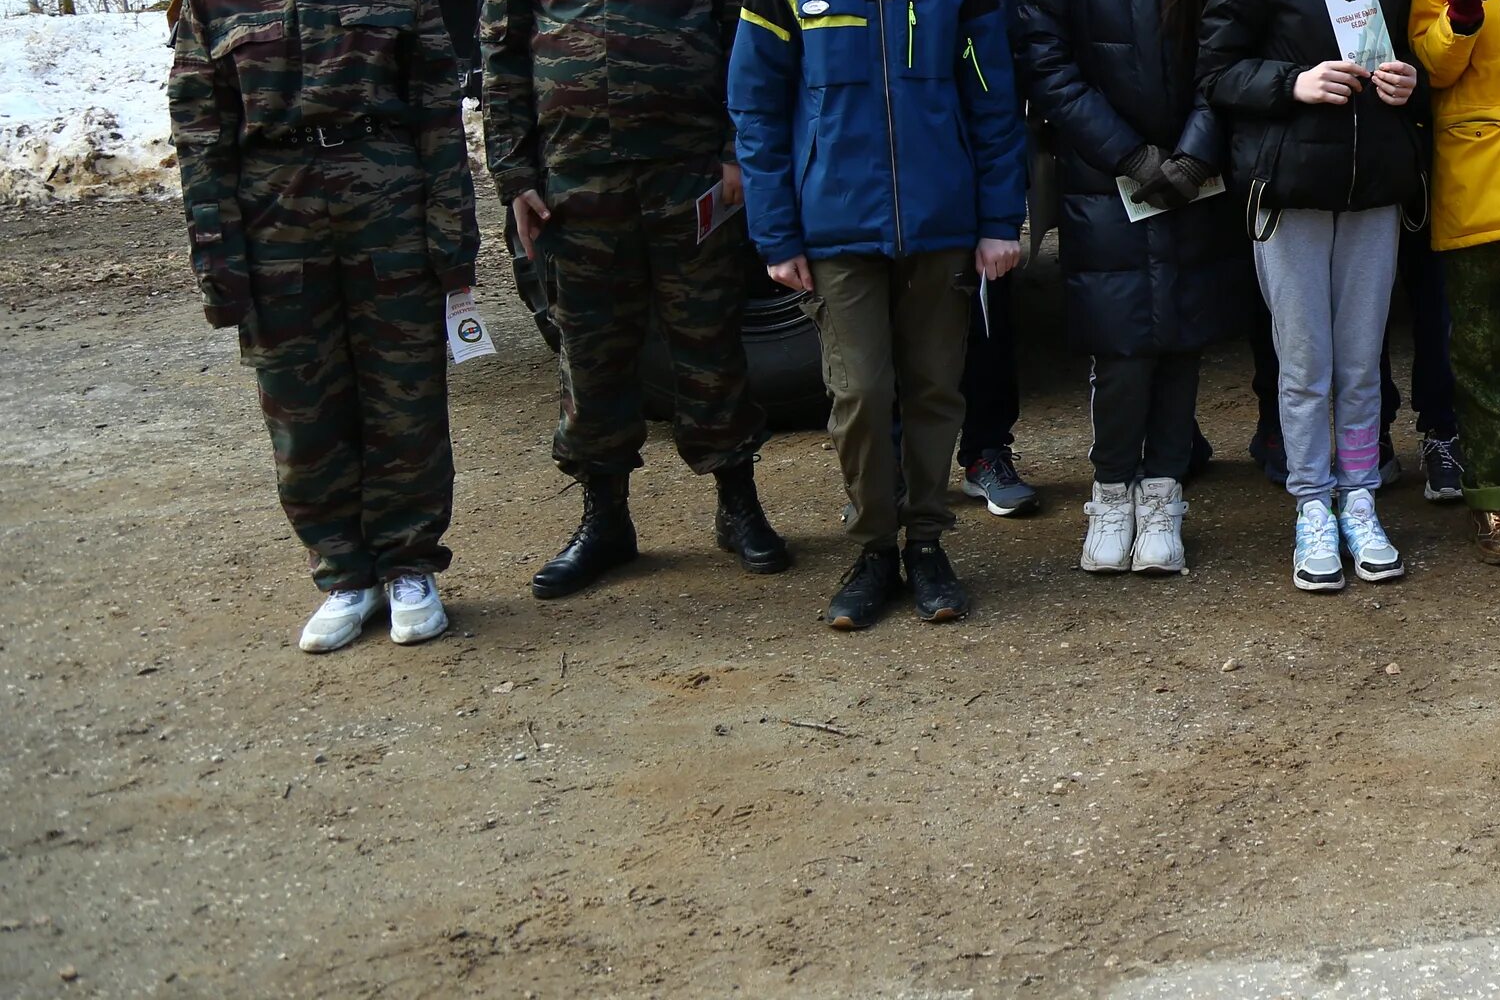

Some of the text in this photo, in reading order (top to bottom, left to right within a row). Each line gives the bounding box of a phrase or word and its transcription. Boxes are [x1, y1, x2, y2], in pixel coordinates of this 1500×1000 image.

[1336, 14, 1355, 24] ЧТОБЫ
[1362, 8, 1377, 17] БЫЛО
[1351, 19, 1367, 28] БЕДЫ
